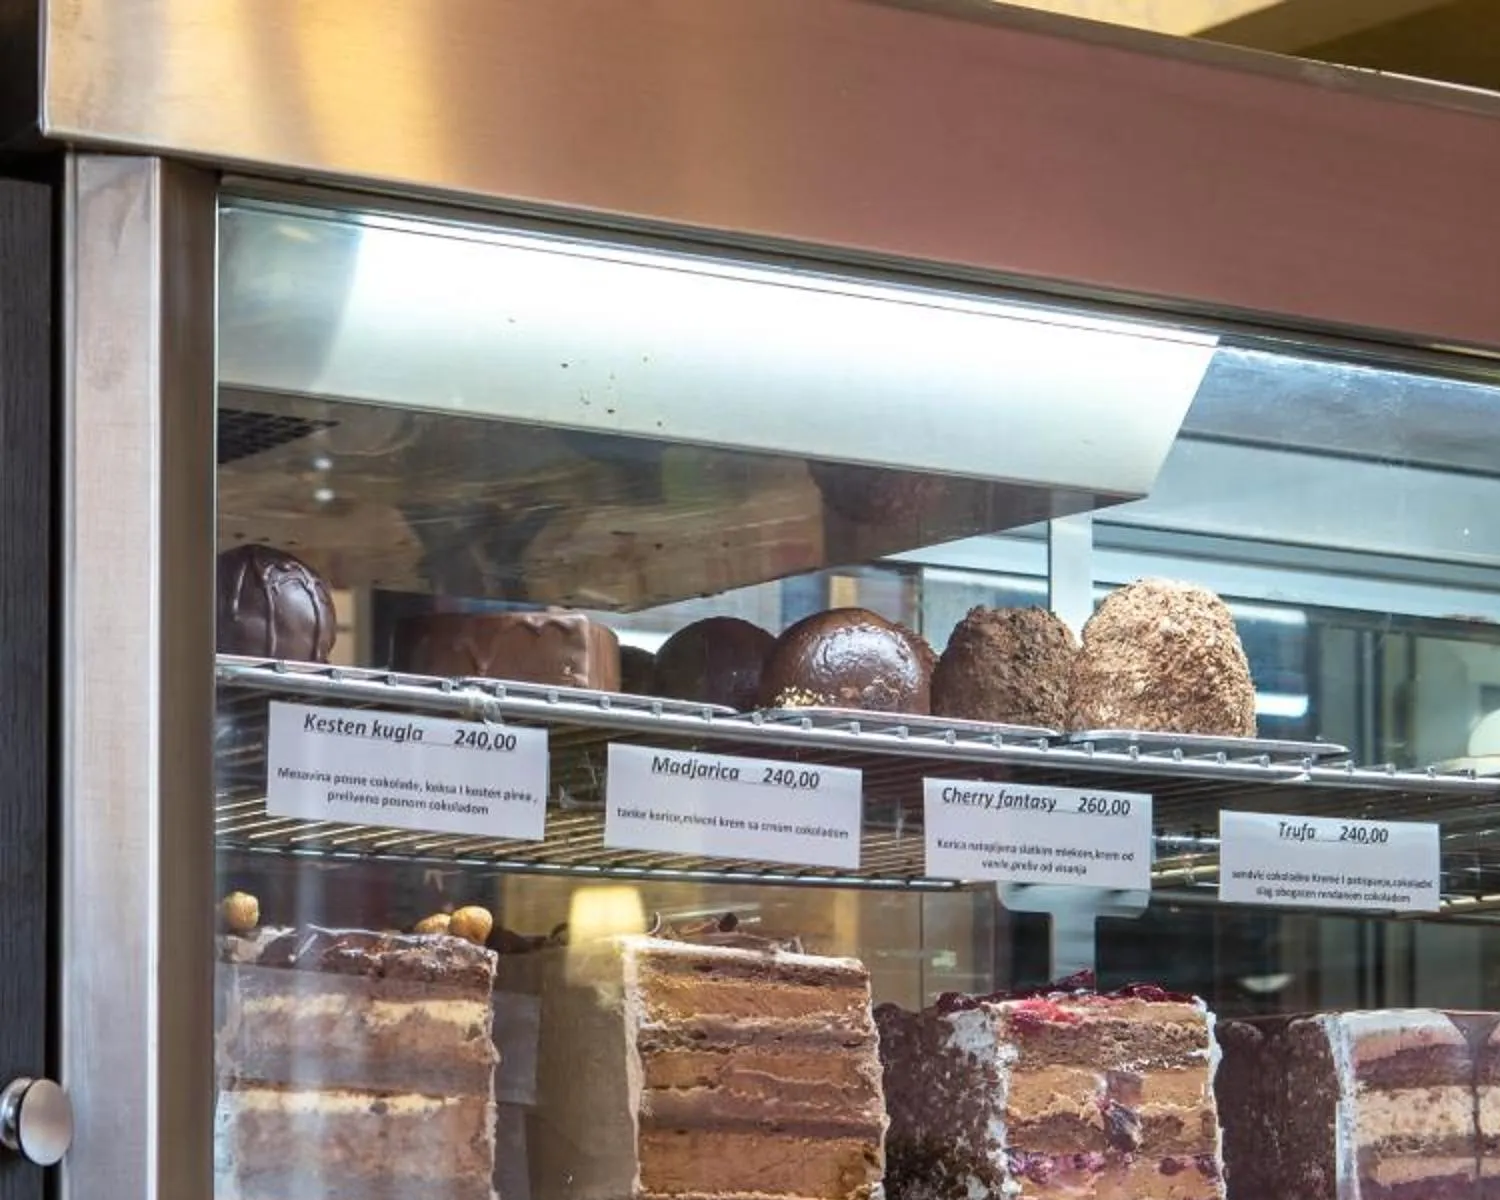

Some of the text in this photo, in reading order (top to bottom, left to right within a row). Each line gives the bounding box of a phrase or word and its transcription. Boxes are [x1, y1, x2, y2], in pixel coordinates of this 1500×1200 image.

[304, 713, 517, 752] Kesten kugla 240,00
[652, 756, 820, 789] Madjarica 240,00
[942, 787, 1130, 816] Cherry fantasy 260,00
[1278, 822, 1389, 844] Trufa 240,00
